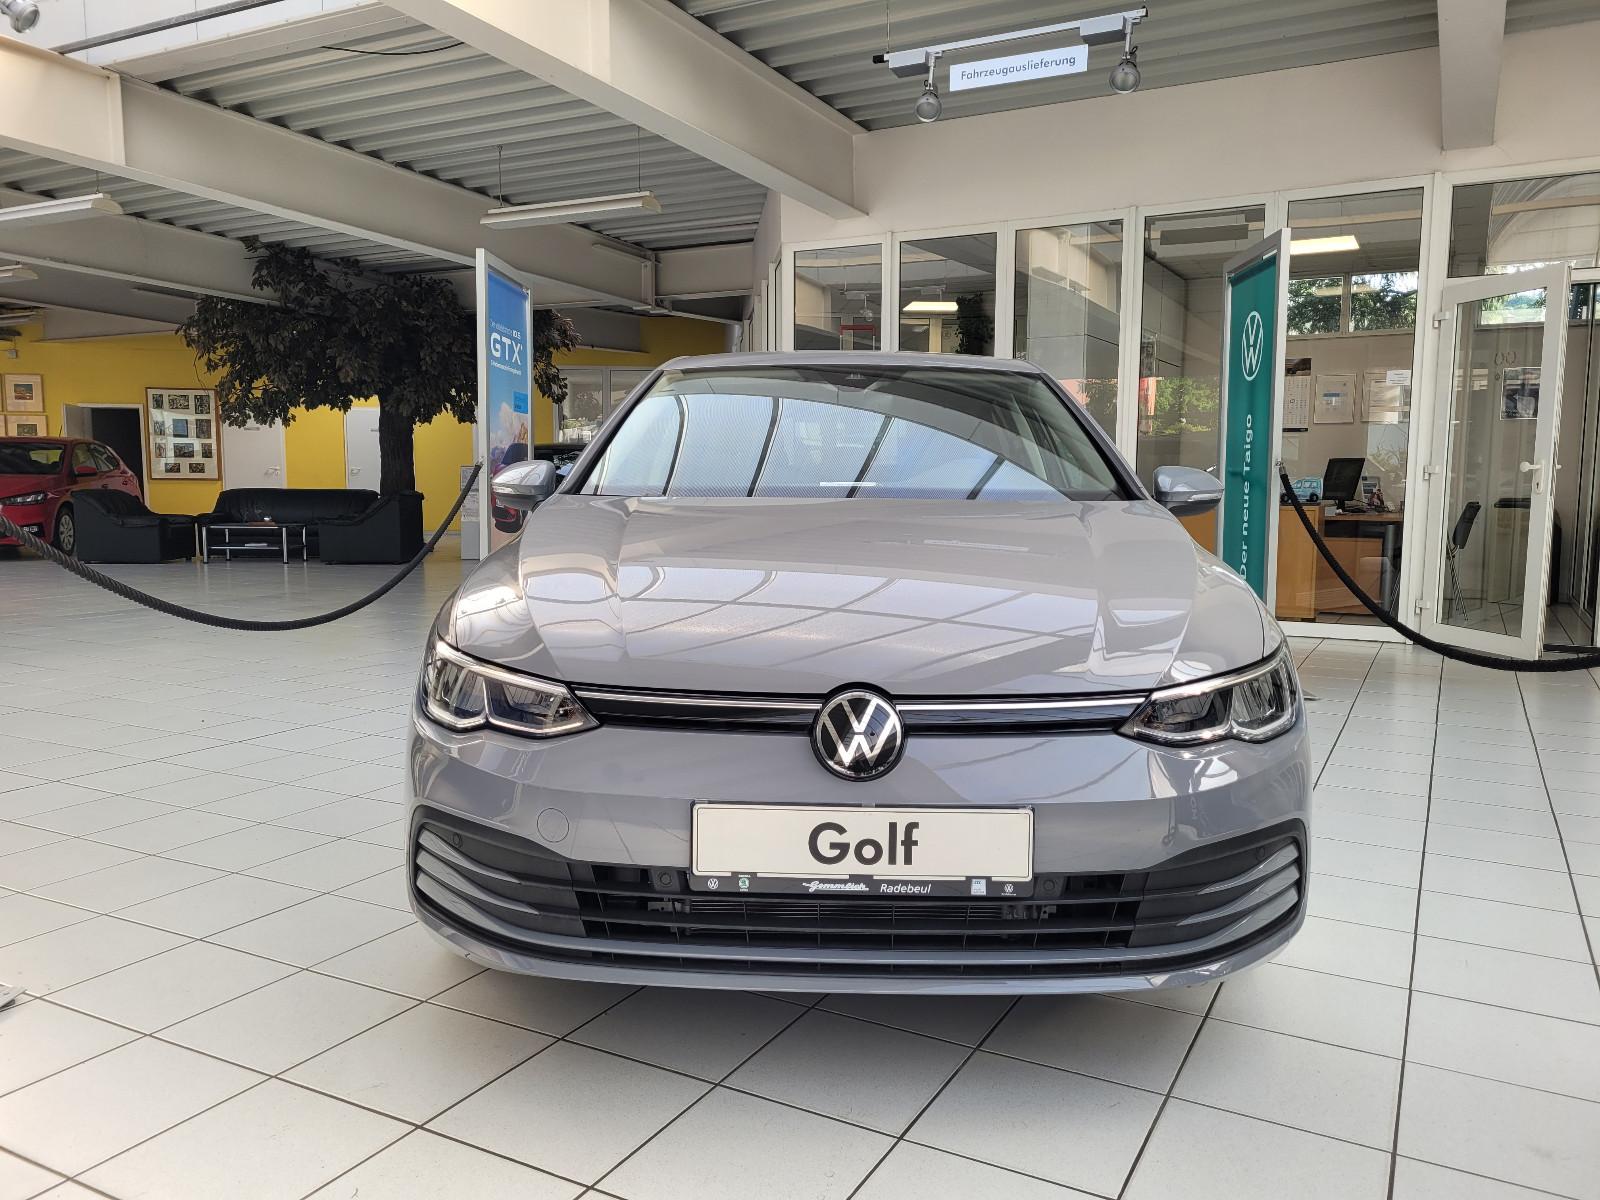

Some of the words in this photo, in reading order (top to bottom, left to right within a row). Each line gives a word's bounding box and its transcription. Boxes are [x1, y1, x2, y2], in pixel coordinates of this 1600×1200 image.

[960, 55, 1076, 81] Fahrzeugauslieferung
[1243, 413, 1254, 477] Taigo
[1242, 480, 1250, 536] neue
[1239, 541, 1248, 581] Der
[808, 821, 920, 866] Golf
[879, 883, 932, 895] Radebeul
